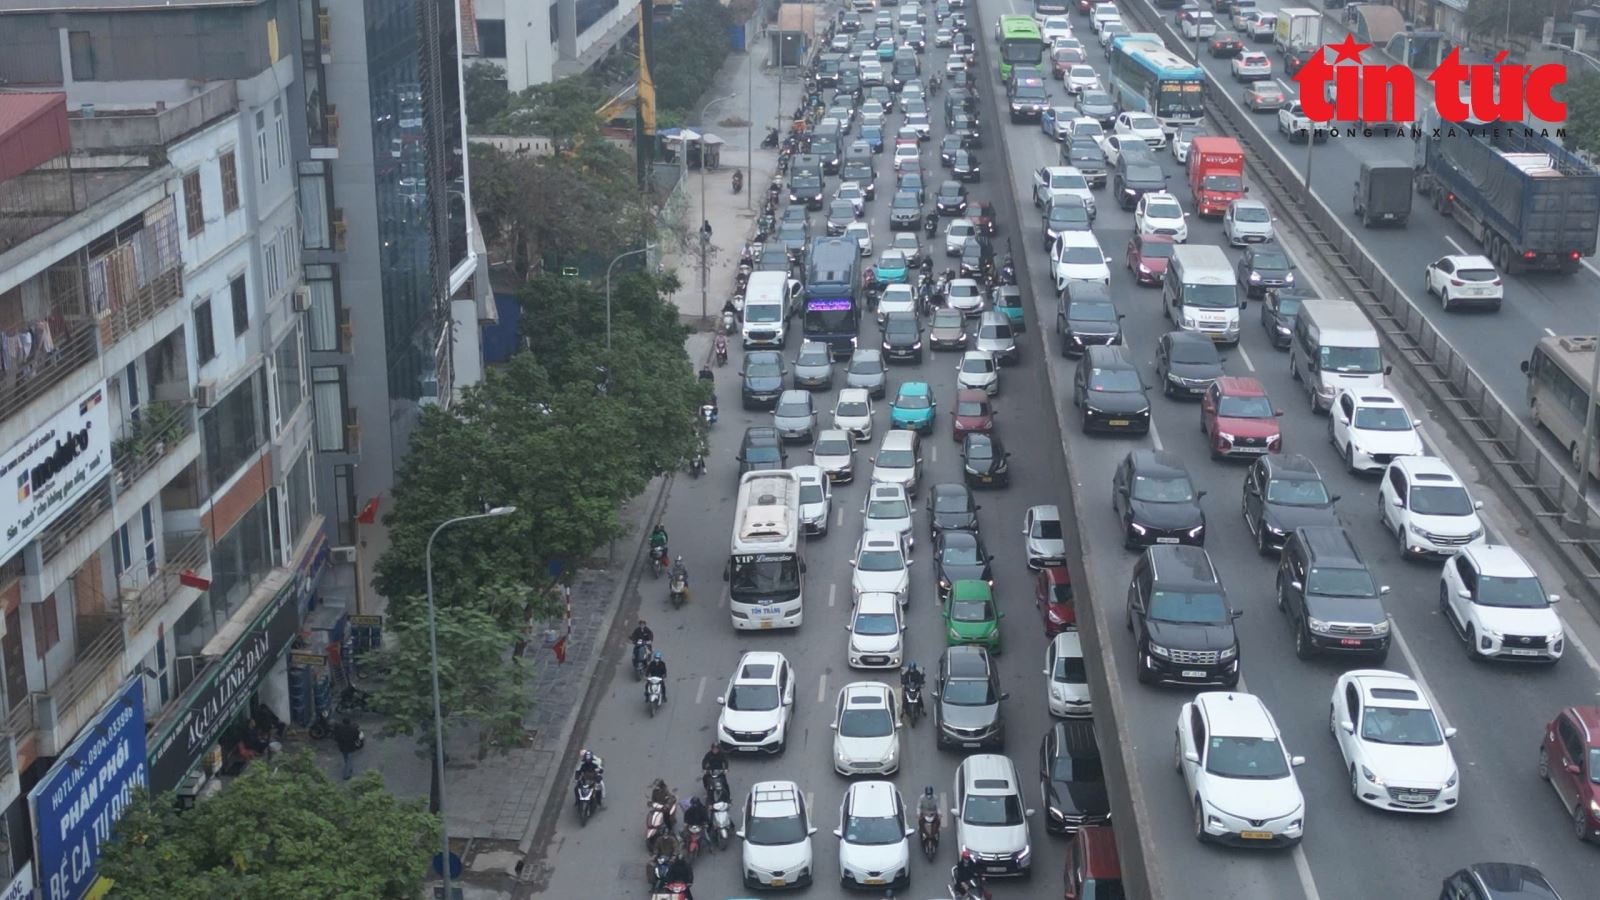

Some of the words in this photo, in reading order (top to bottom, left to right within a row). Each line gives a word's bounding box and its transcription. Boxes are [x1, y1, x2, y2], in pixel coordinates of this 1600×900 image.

[735, 555, 754, 563] VIP
[60, 778, 98, 841] PHÂN
[98, 737, 130, 793] PHỐI
